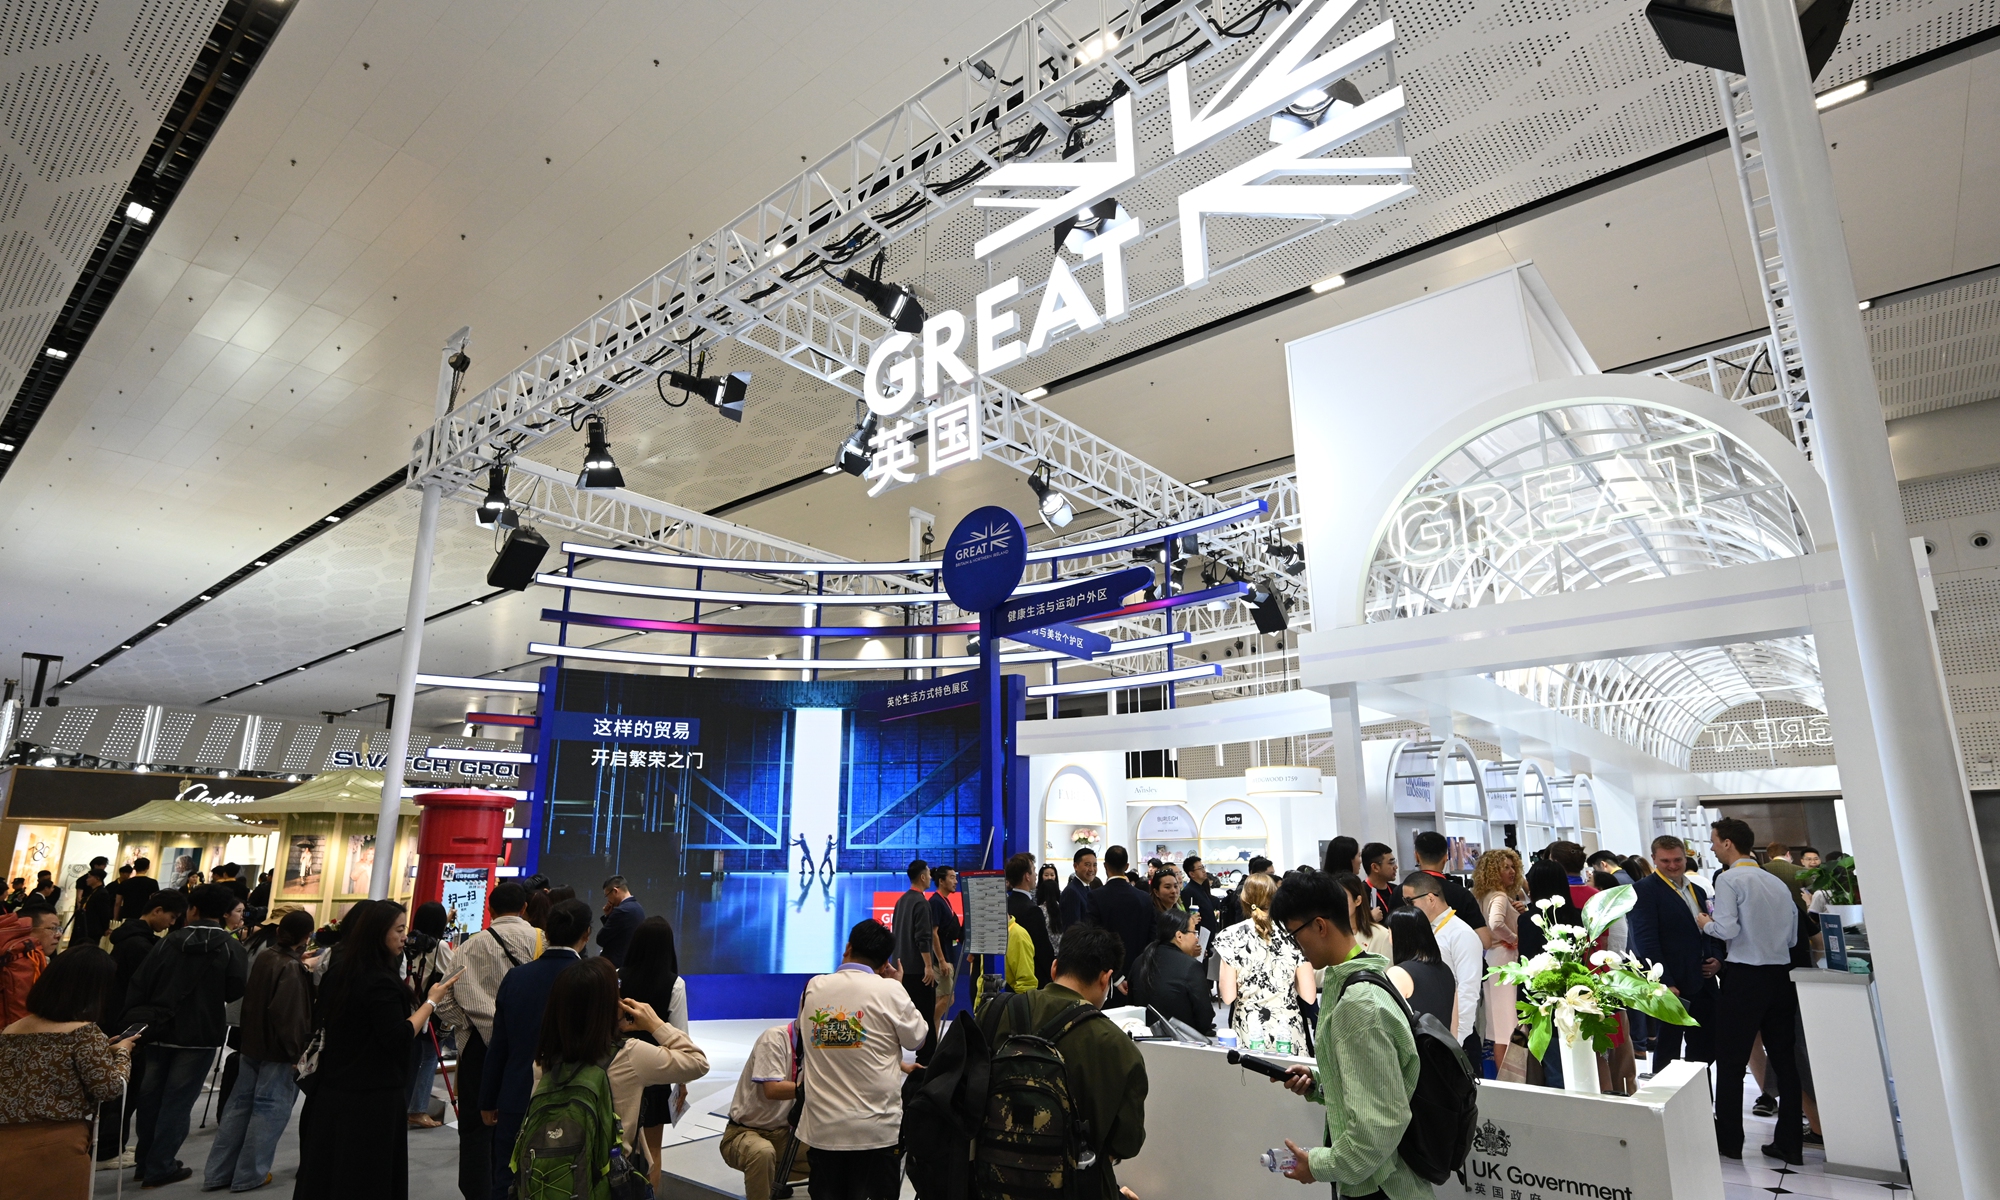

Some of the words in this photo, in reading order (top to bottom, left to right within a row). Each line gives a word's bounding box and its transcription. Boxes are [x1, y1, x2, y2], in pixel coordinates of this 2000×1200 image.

[864, 217, 1144, 417] GREAT
[867, 394, 982, 498] 英国
[1388, 433, 1717, 568] GREAT
[955, 542, 988, 561] GREAT
[1007, 587, 1108, 623] 健康生活与运动户外区
[1027, 627, 1084, 649] 尚与美妆个护区
[887, 680, 969, 708] 英伦生活方式特色展区
[592, 717, 690, 740] 这样的贸易
[333, 751, 450, 773] SWCH
[591, 748, 704, 770] 开启繁荣之门
[448, 890, 477, 905] 扫一扫
[1472, 1159, 1503, 1182] UK
[1506, 1165, 1633, 1200] Government
